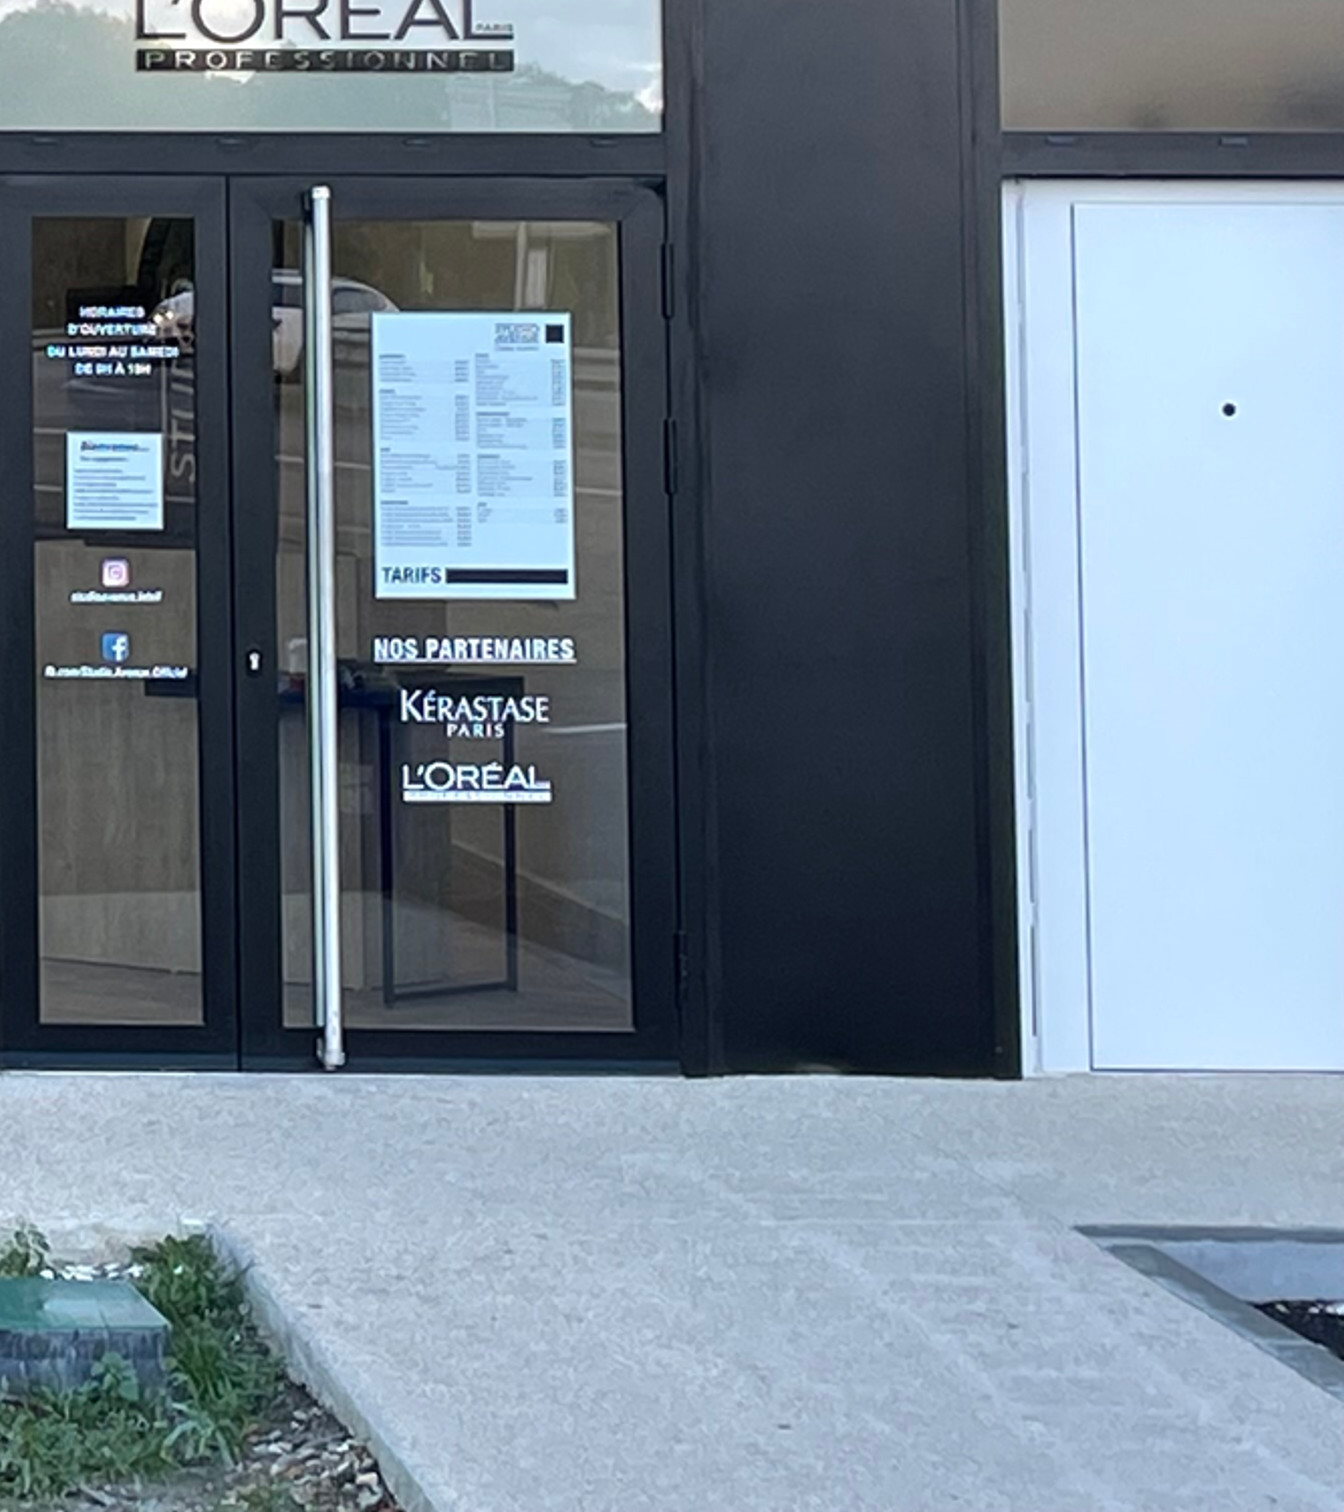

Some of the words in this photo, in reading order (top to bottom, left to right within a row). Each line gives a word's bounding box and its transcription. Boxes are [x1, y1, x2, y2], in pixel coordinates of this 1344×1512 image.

[144, 51, 507, 71] PROFESSIONNEL
[47, 346, 66, 358] DU
[68, 346, 107, 358] LUNDI
[109, 346, 128, 358] AU
[382, 567, 442, 584] TARIFS
[374, 638, 419, 659] NOS
[425, 638, 575, 659] PARTENAIRES
[400, 689, 550, 722] KÉRASTASE
[447, 723, 504, 737] PARIS
[402, 761, 551, 789] L'ORÉAL
